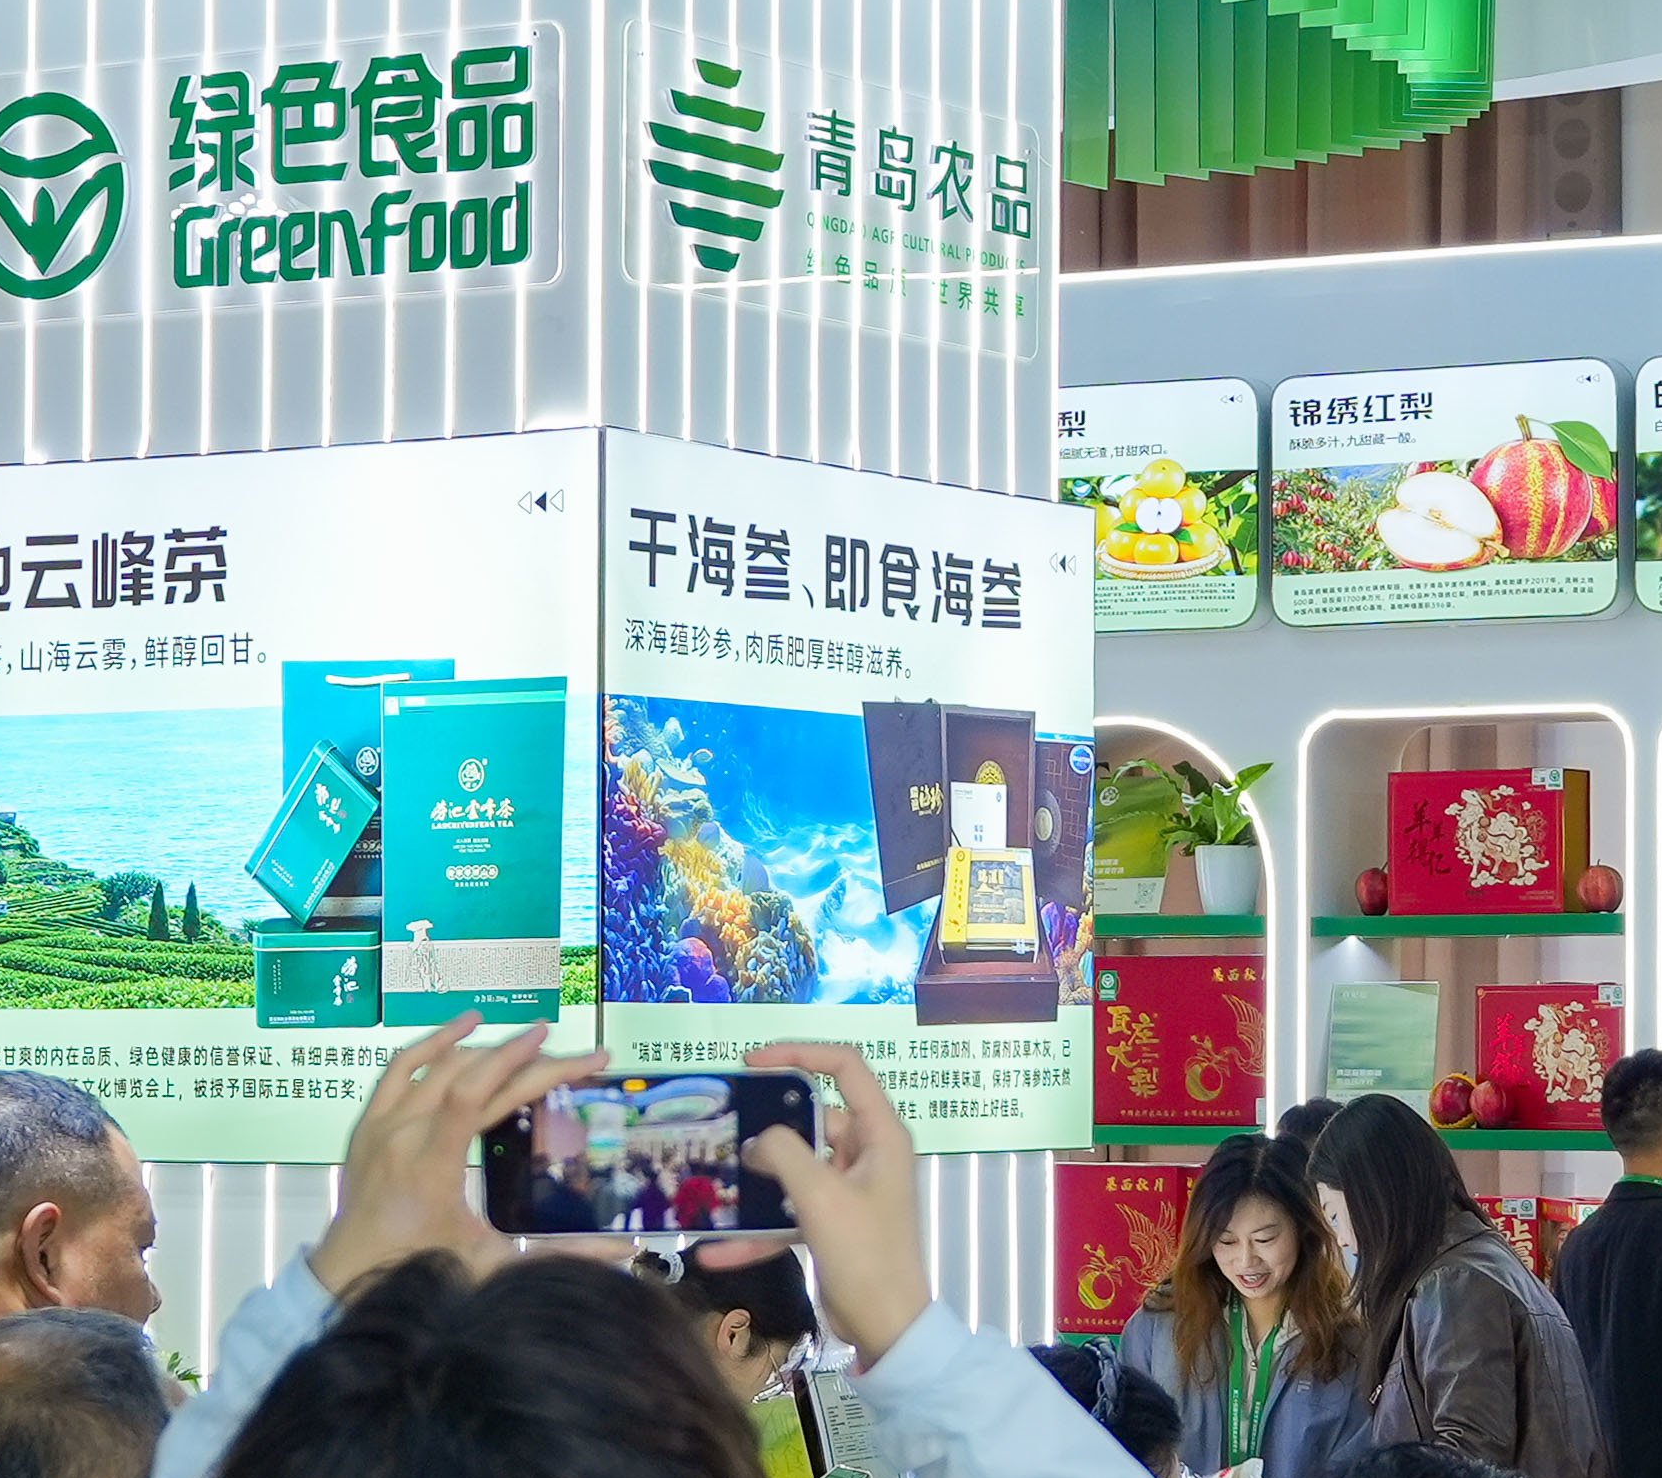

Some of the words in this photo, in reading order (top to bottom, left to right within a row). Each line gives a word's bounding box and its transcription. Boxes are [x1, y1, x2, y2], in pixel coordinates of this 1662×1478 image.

[169, 45, 533, 191] 绿色食品
[806, 108, 1031, 239] 青岛农品
[1289, 392, 1433, 427] 锦绣红梨
[628, 508, 1022, 629] 干海参、即食海参
